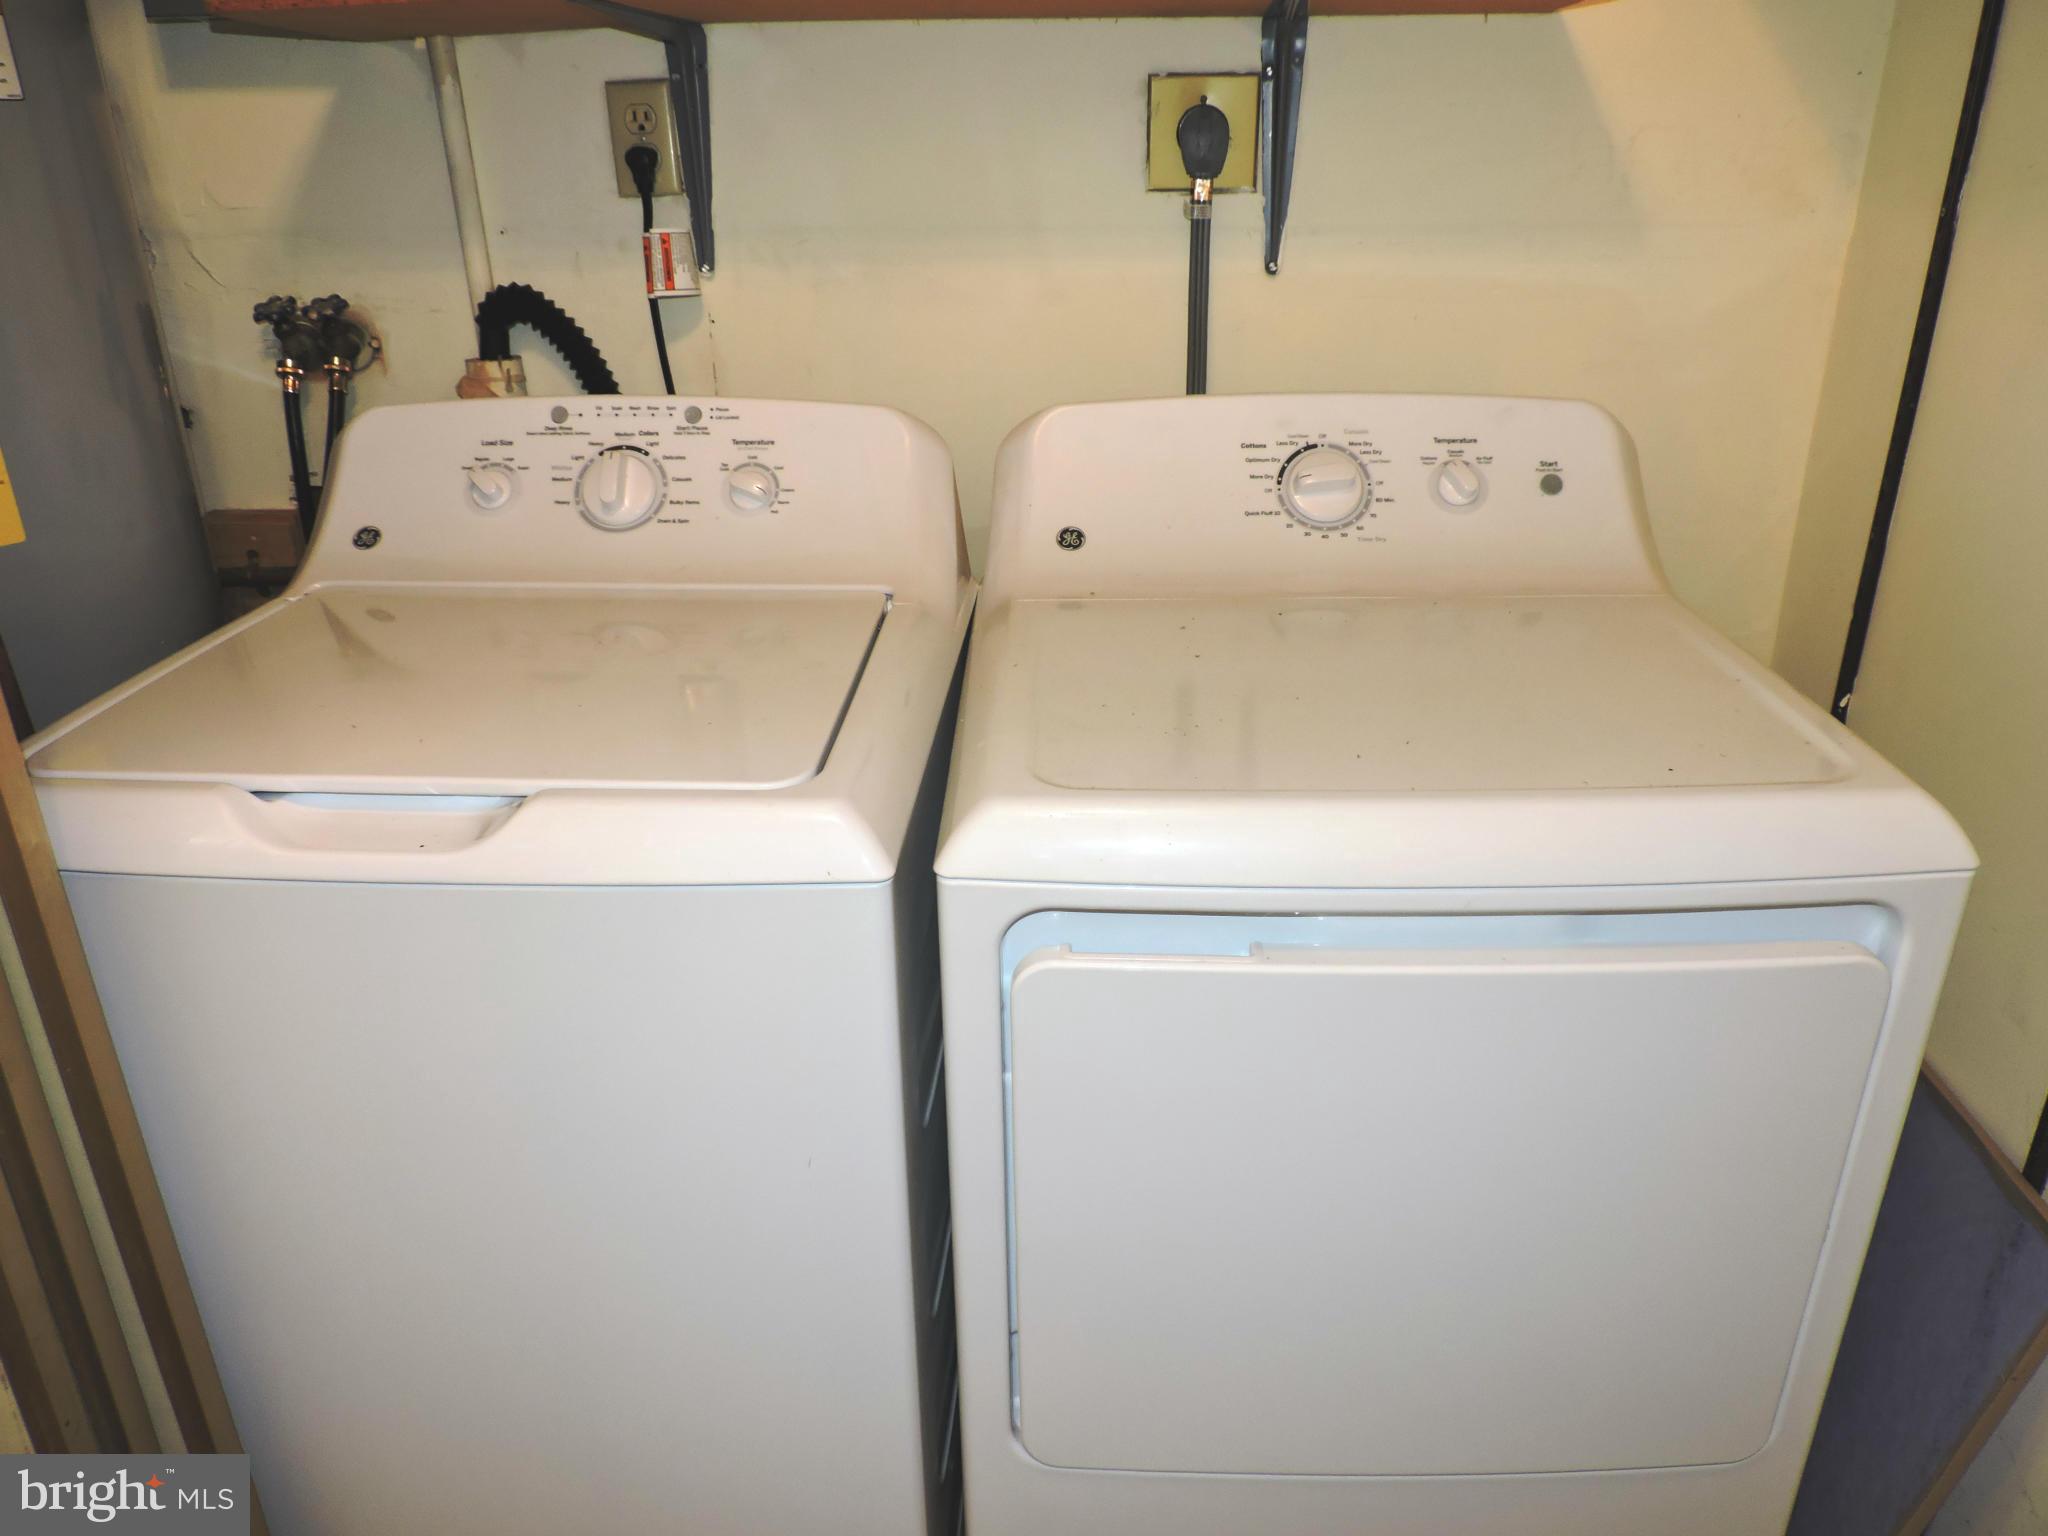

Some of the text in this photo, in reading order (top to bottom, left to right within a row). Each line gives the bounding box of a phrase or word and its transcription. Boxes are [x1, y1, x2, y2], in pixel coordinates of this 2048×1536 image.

[731, 438, 775, 446] Temperature
[1433, 436, 1478, 445] Temperature
[1245, 456, 1270, 464] Optimum
[1539, 460, 1559, 468] Start
[1264, 473, 1274, 481] Dry
